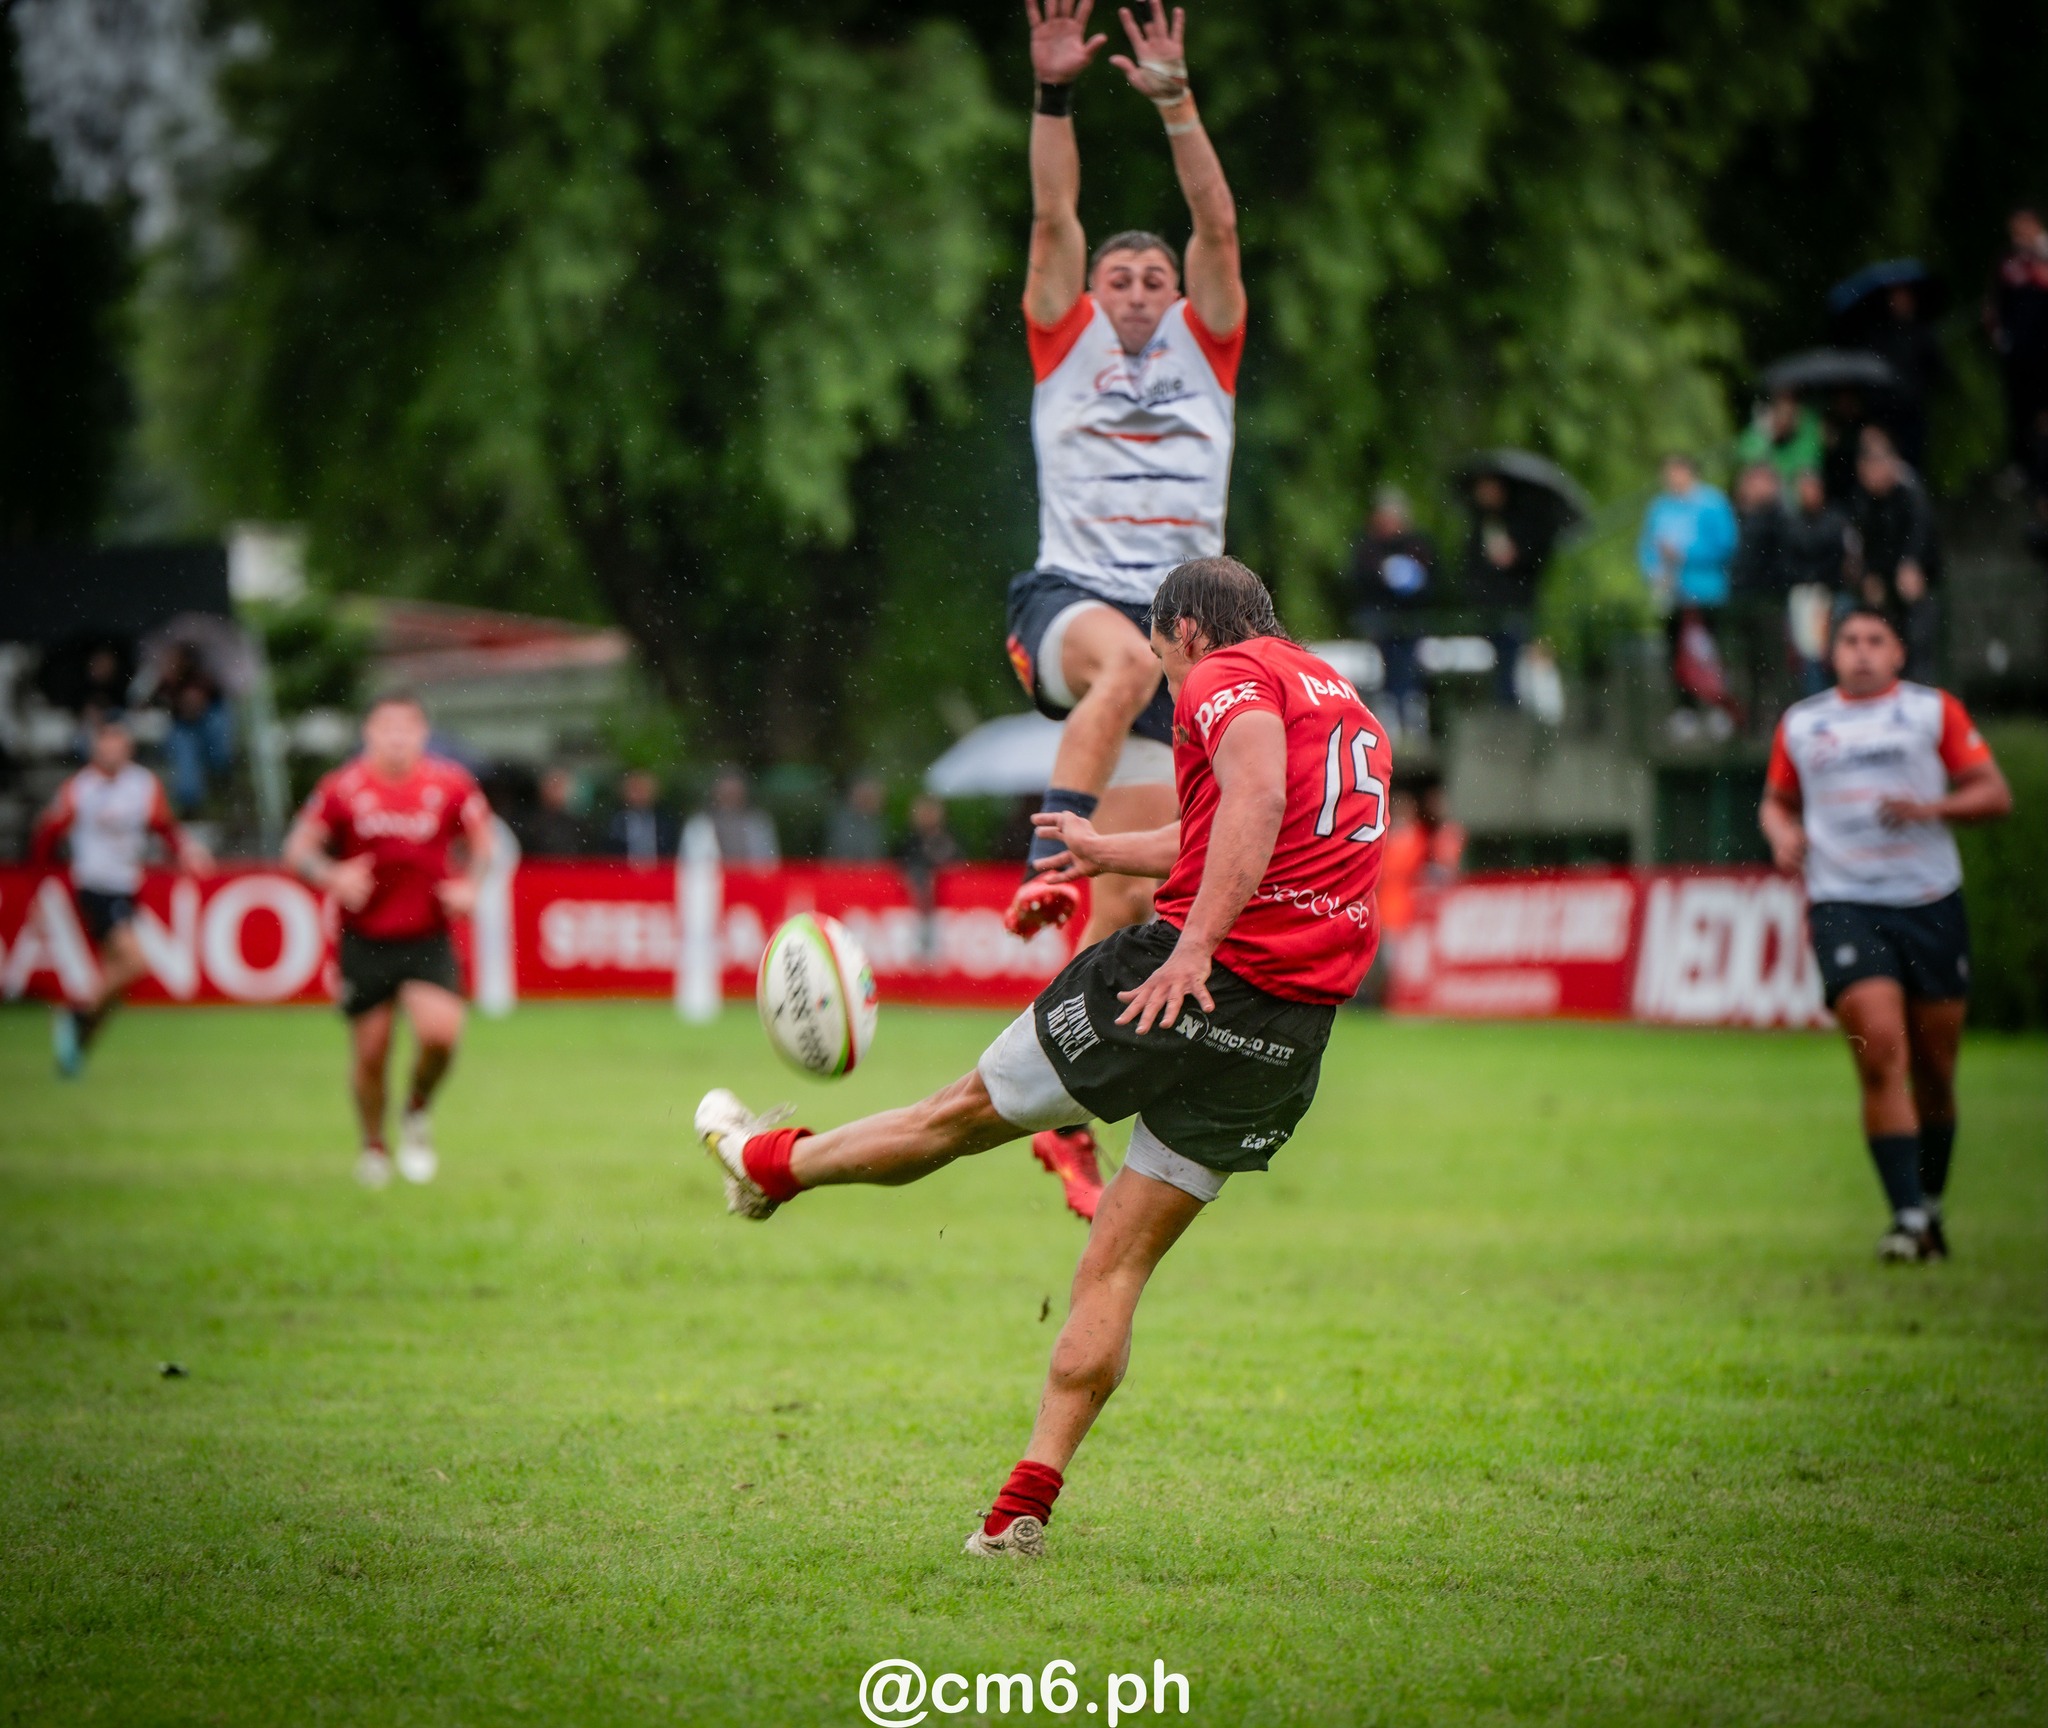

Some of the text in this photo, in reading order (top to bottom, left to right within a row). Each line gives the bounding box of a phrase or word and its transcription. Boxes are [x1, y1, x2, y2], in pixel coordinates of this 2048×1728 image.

[1314, 718, 1387, 844] 15
[0, 873, 341, 1002] ANO
[1047, 1001, 1085, 1064] BRANCA
[1063, 992, 1101, 1050] FERNET
[1266, 1042, 1295, 1060] FIT
